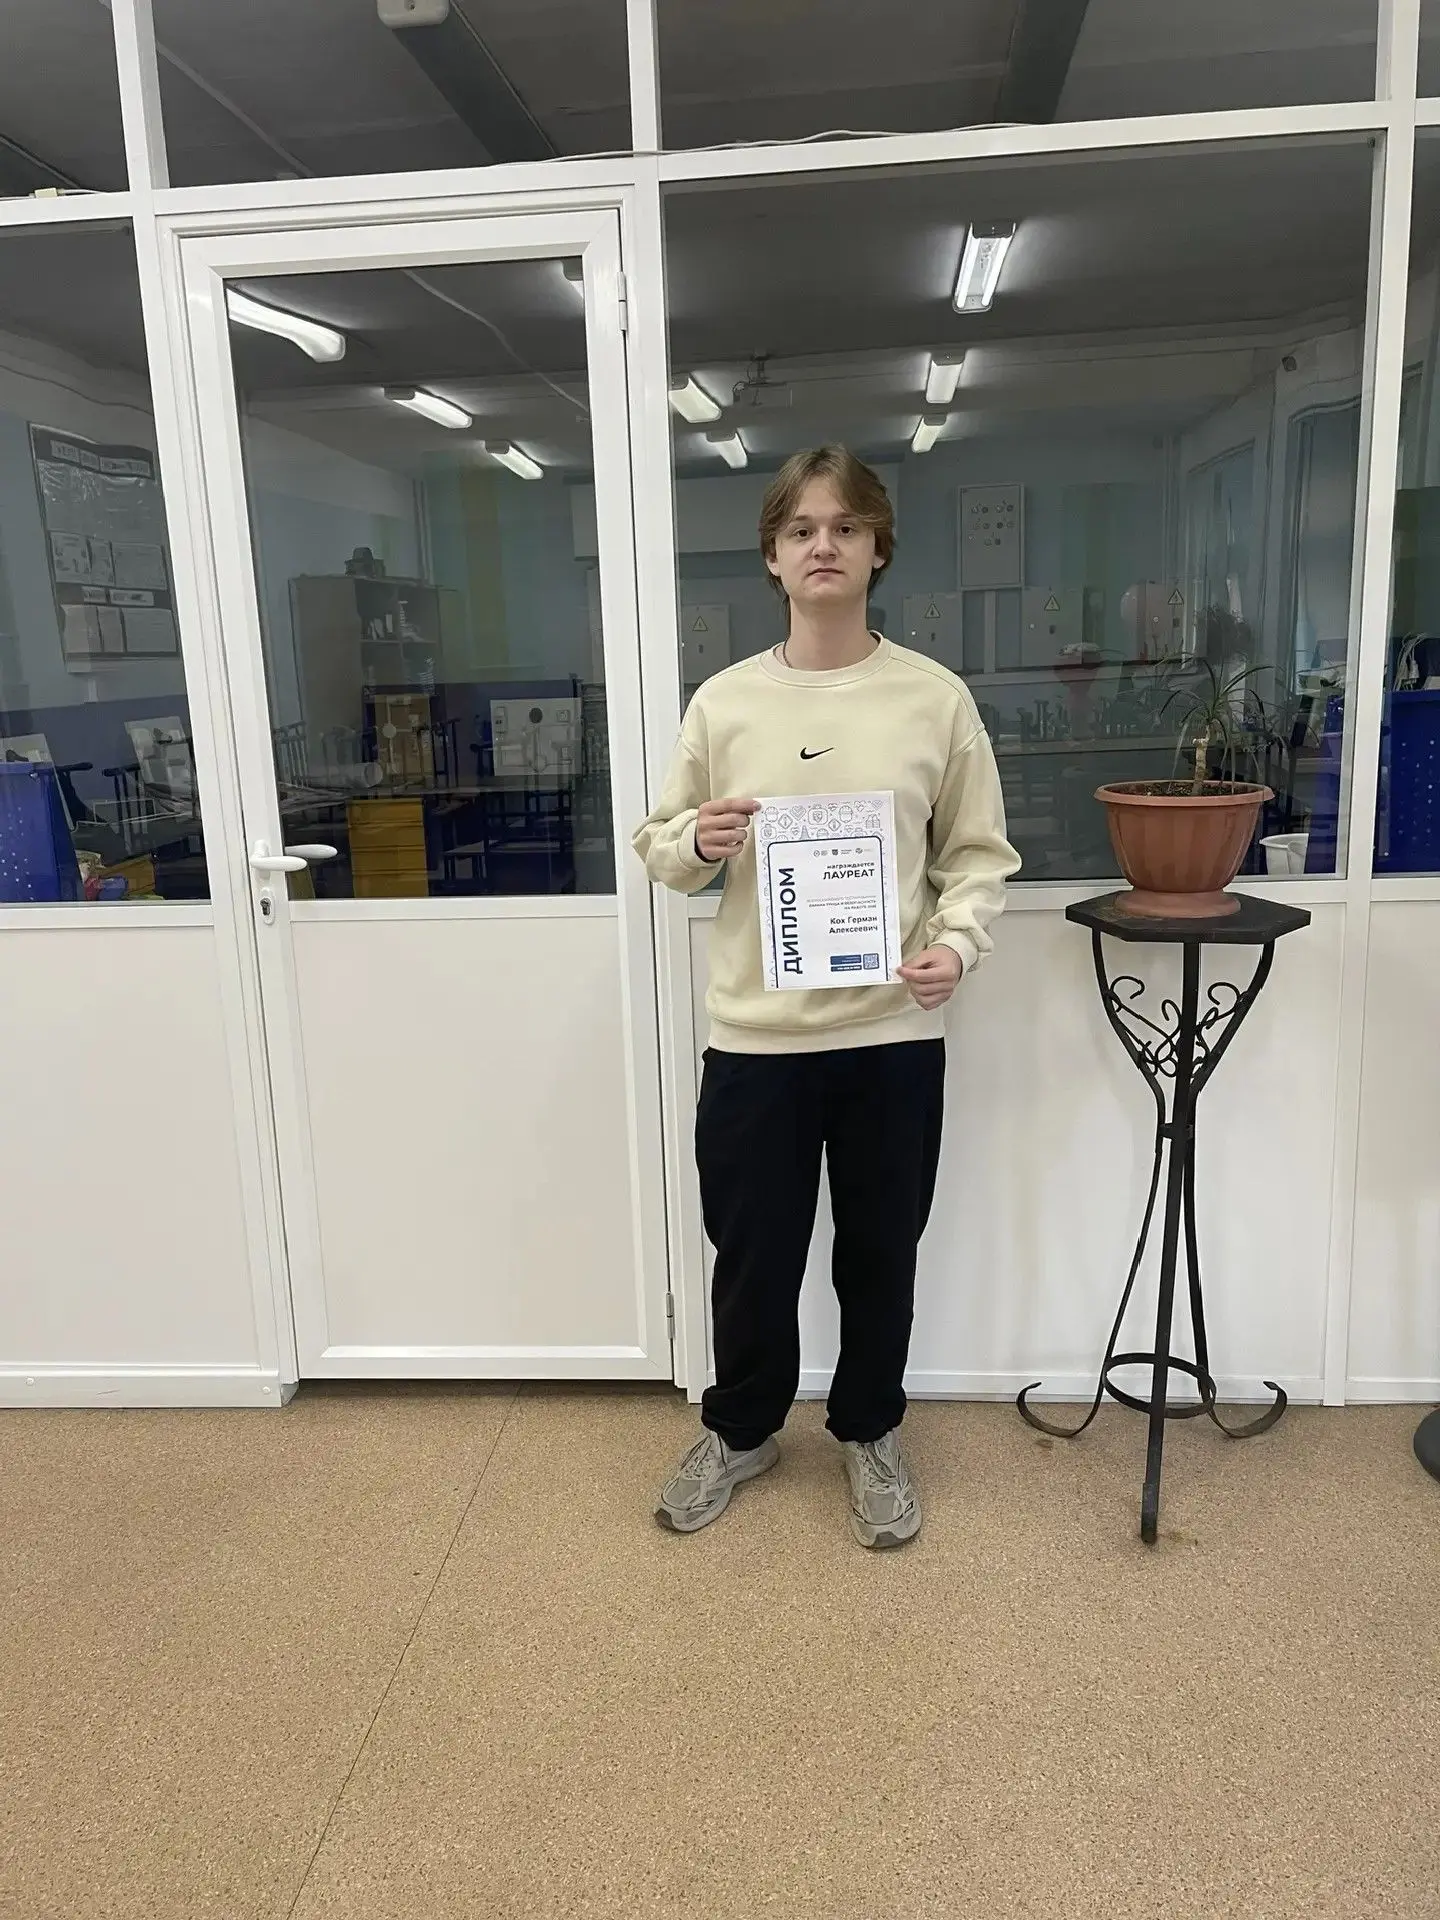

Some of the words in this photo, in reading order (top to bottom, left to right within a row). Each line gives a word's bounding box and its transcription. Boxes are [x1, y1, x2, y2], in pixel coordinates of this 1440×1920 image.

[823, 869, 875, 880] ЛАУРЕАТ
[778, 868, 803, 974] ДИПЛОМ
[847, 916, 878, 924] Герман
[829, 926, 878, 934] Алексеевич
